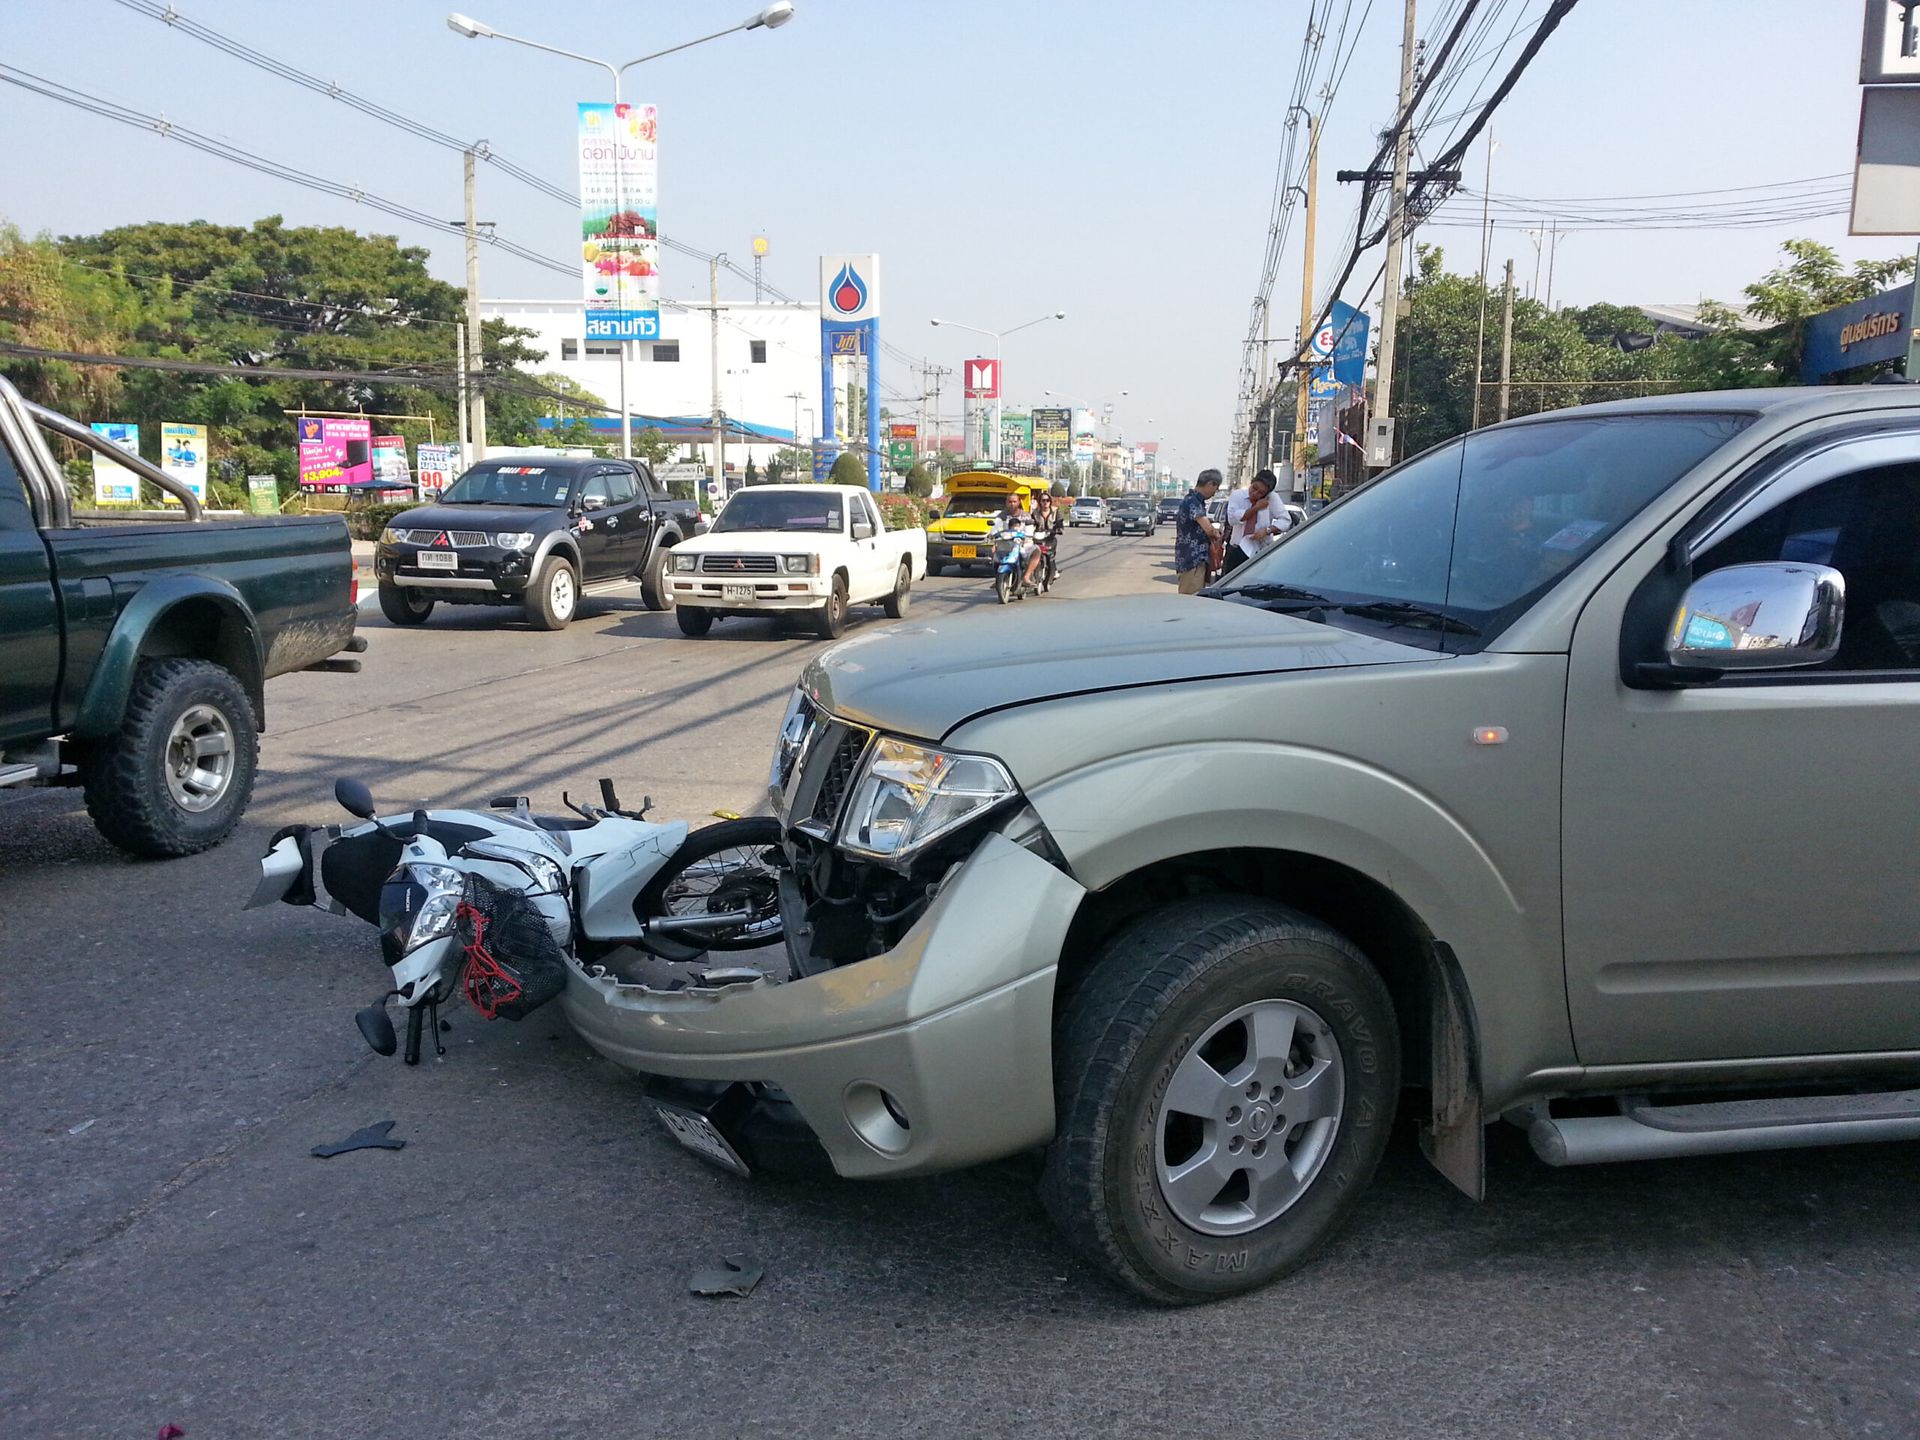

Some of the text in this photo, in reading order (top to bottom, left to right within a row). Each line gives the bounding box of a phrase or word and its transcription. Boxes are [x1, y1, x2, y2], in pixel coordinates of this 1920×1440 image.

[420, 452, 447, 462] SALE
[420, 471, 443, 488] 90
[1282, 973, 1378, 1075] BRAVO
[1136, 1143, 1249, 1274] MAXXIS
